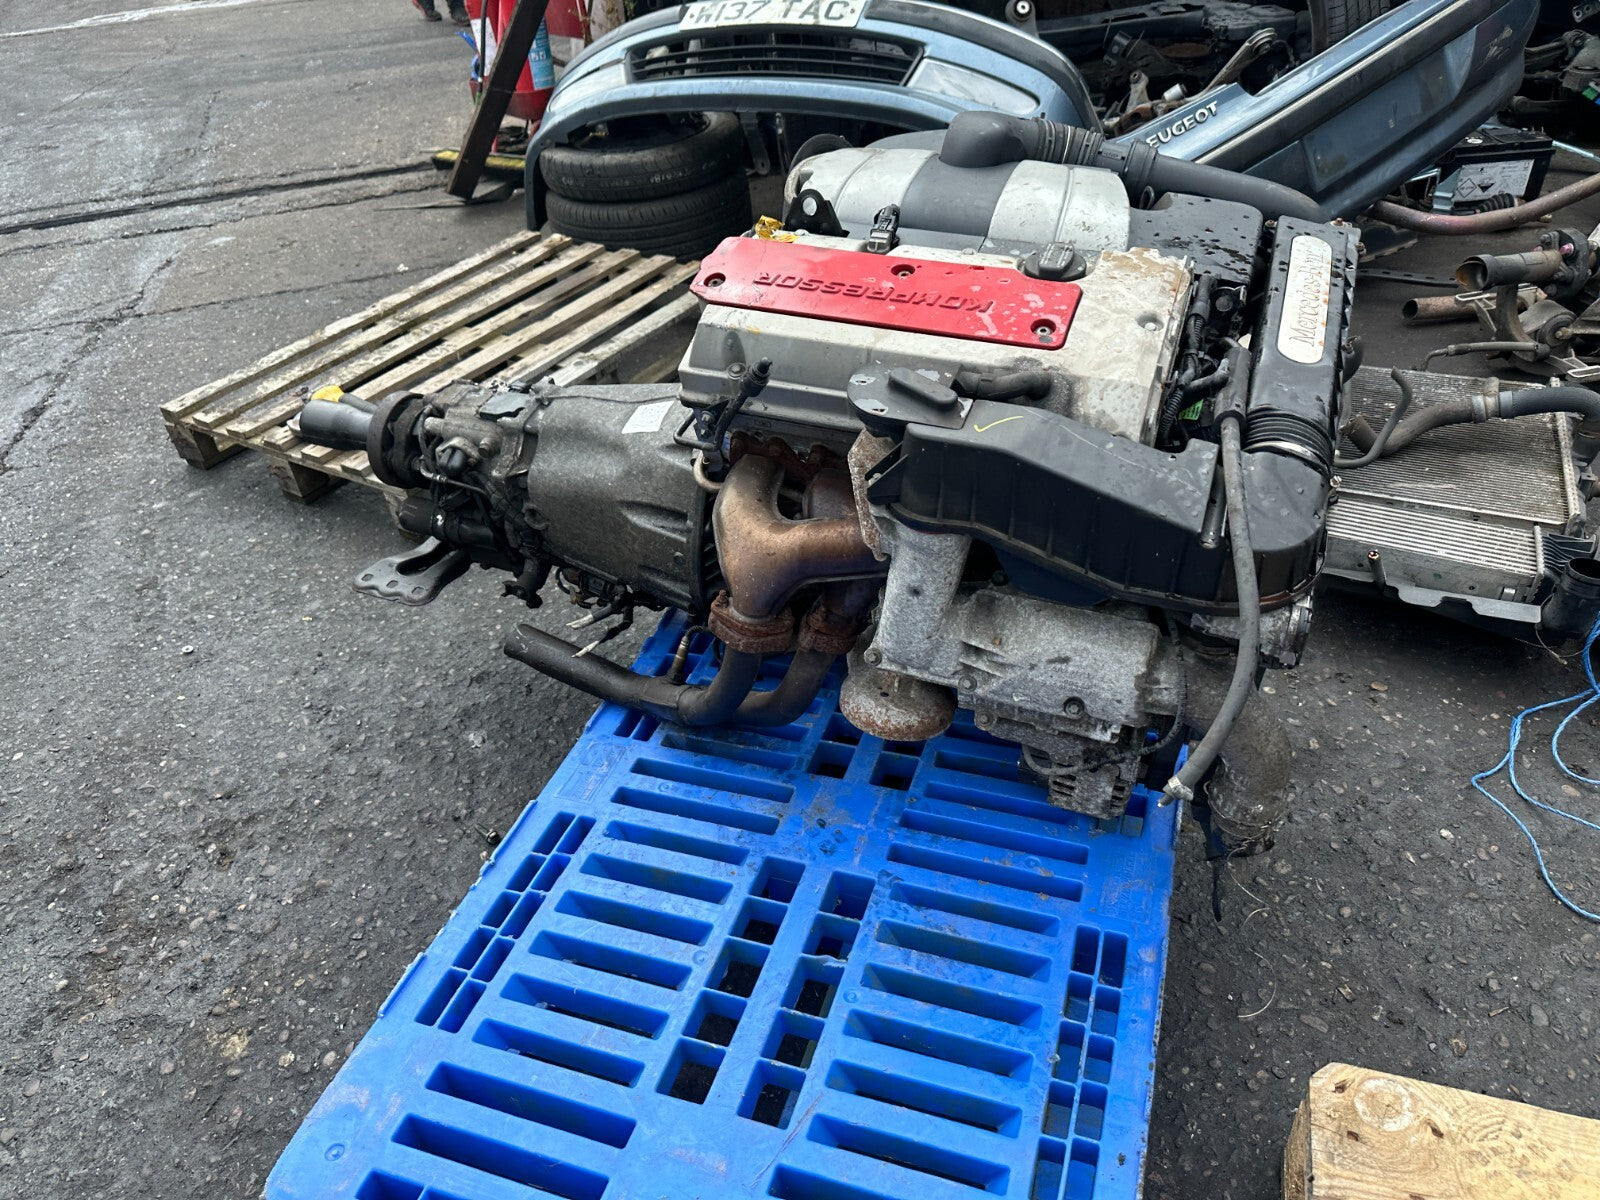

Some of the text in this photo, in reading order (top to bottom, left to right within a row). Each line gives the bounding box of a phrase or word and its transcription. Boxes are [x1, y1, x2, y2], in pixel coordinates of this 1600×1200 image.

[782, 0, 850, 20] TAC
[1145, 100, 1218, 148] EUGEOT
[753, 272, 994, 313] KOMPRESSOR
